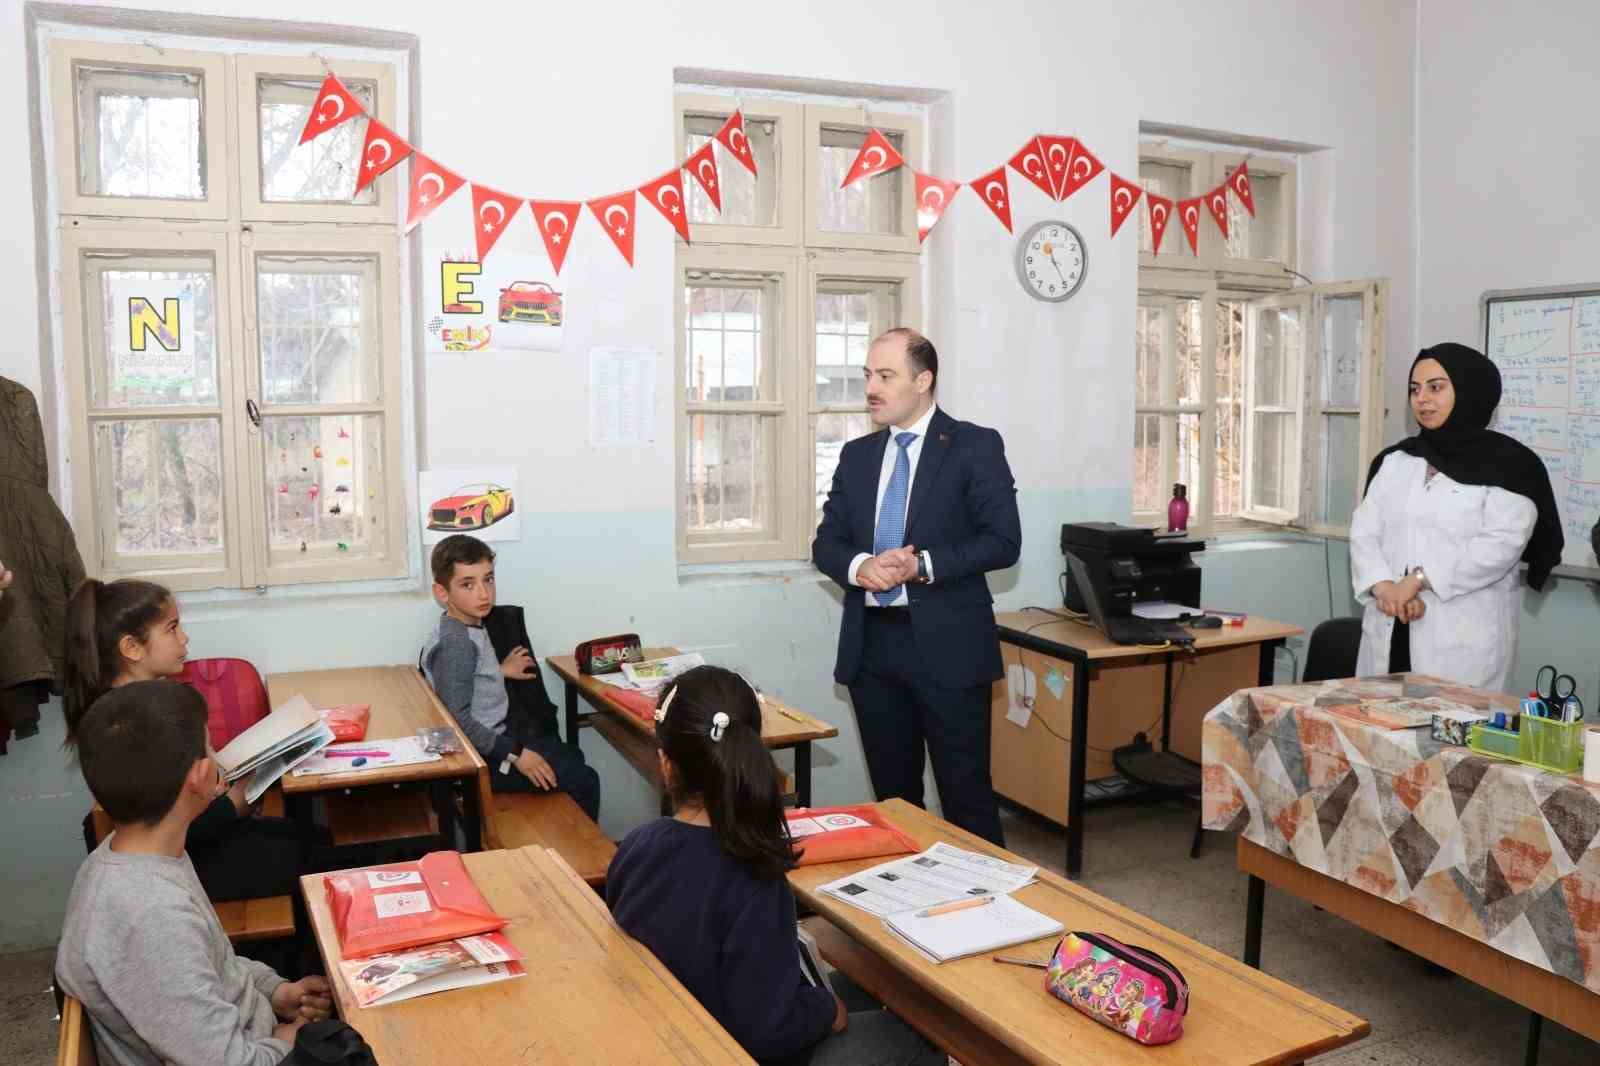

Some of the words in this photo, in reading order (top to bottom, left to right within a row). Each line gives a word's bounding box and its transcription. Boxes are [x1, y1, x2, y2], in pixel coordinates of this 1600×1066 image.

[1032, 241, 1041, 250] 10
[1069, 242, 1078, 251] 2
[1026, 256, 1033, 265] 9
[1074, 257, 1079, 266] 3
[1069, 271, 1075, 279] 4
[441, 261, 484, 314] E
[1037, 280, 1043, 289] 7
[1049, 284, 1055, 293] 6
[1062, 280, 1068, 289] 5
[128, 296, 181, 352] N
